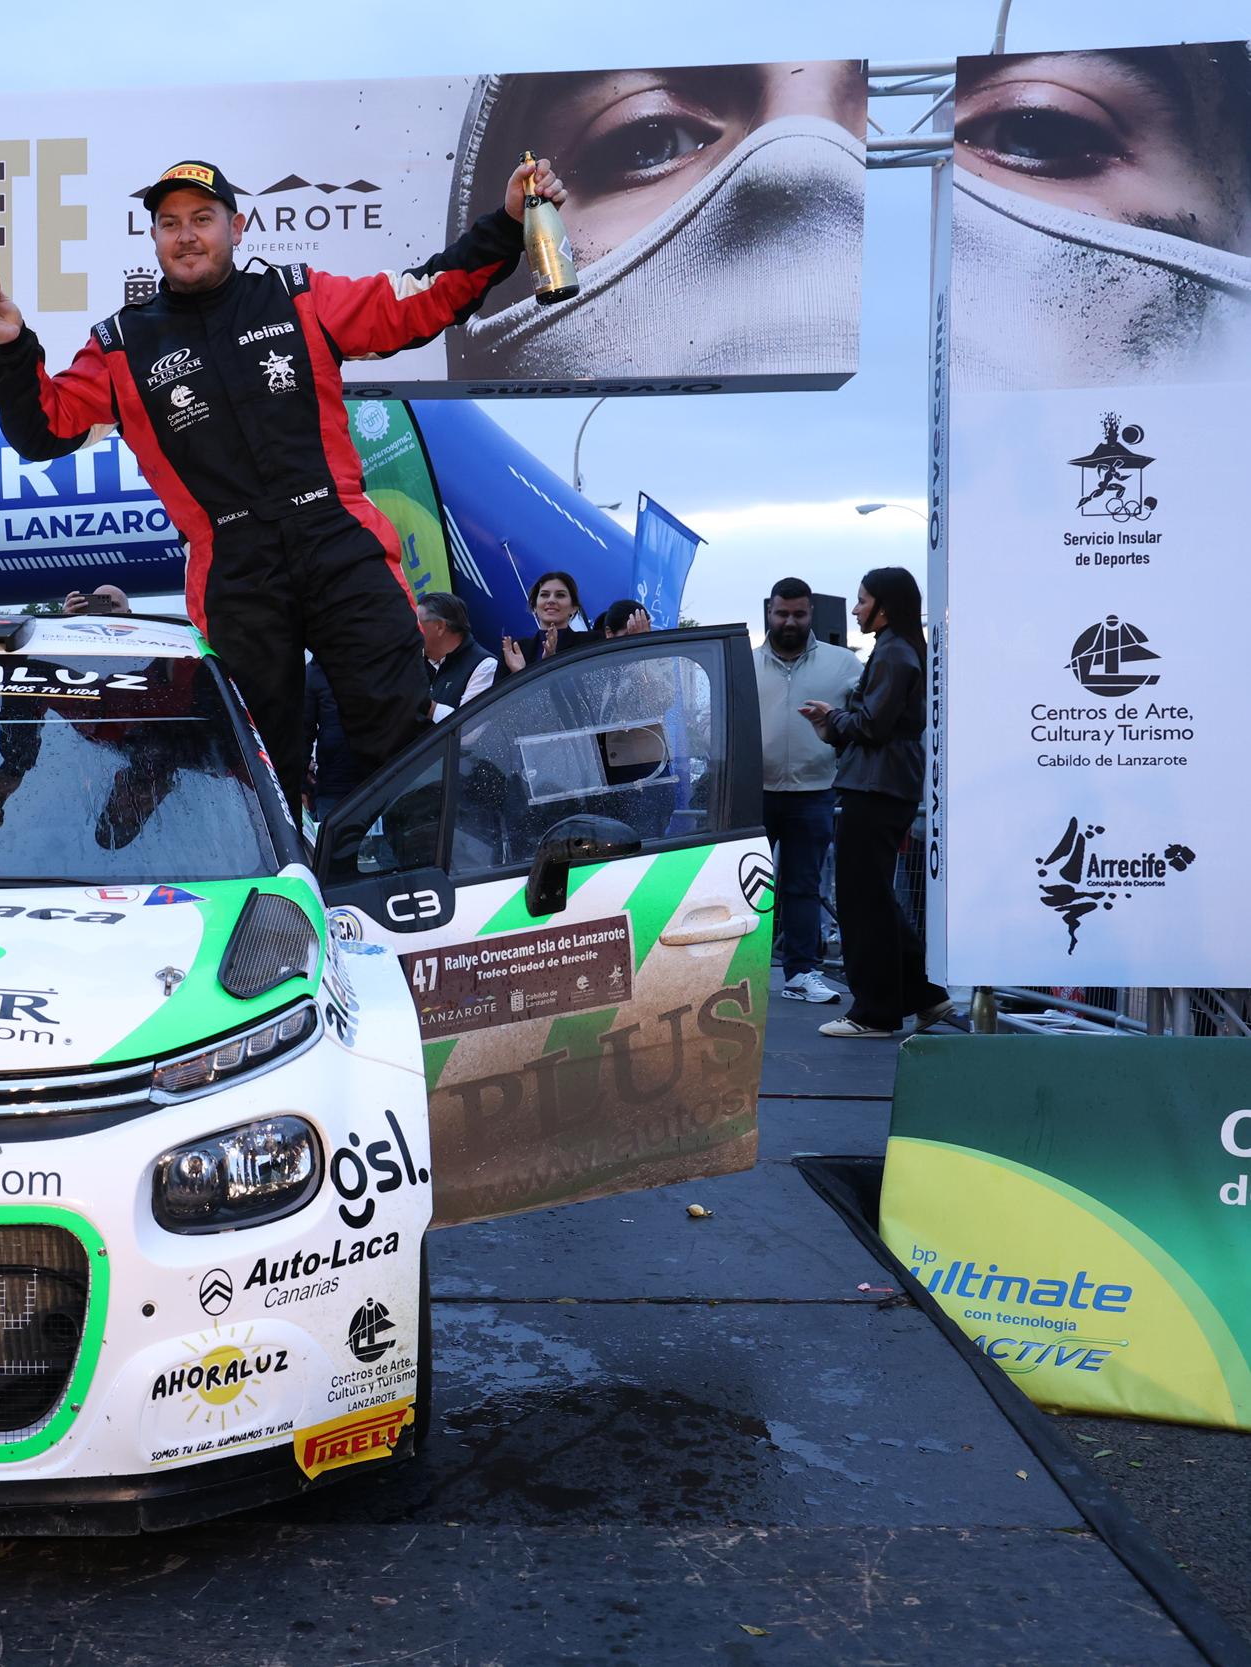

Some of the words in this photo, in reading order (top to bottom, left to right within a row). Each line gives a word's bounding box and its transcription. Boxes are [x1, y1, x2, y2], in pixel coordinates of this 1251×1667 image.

[127, 204, 383, 236] LAROTE
[246, 241, 320, 254] DIFERENTE
[238, 322, 295, 346] aleima
[147, 369, 175, 386] PLUS
[177, 359, 202, 374] CAR
[929, 291, 946, 551] Orvecame
[4, 505, 171, 543] LANZARO
[1063, 532, 1115, 547] Servicio
[1118, 530, 1163, 546] Insular
[1075, 552, 1092, 567] de
[1094, 551, 1151, 569] Deportes
[41, 686, 60, 695] TU
[66, 688, 101, 697] VIDA
[1031, 703, 1108, 721] Centros
[1114, 702, 1138, 720] de
[1145, 702, 1194, 721] Arte,
[1031, 725, 1102, 743] Cultura
[1103, 730, 1115, 746] y
[1118, 724, 1195, 742] Turismo
[929, 623, 941, 881] Orvecame
[1037, 753, 1091, 768] Cabildo
[1095, 754, 1113, 768] de
[1117, 753, 1188, 768] Lanzarote
[1086, 853, 1167, 879] Arrecife
[386, 889, 442, 923] C3
[444, 953, 479, 972] Rallye
[480, 945, 536, 965] Orvecame
[537, 939, 556, 956] Isla
[557, 936, 572, 951] de
[573, 927, 626, 948] Lanzarote
[412, 956, 439, 993] 47
[476, 967, 508, 981] Trofeo
[509, 959, 546, 975] Ciudad
[547, 957, 560, 967] de
[561, 950, 599, 966] Arrecife
[420, 1002, 498, 1026] LANZAROTE
[243, 1231, 400, 1290] Auto-Laca
[911, 1245, 937, 1266] bp
[263, 1276, 340, 1309] Canarias
[963, 1308, 992, 1322] con
[996, 1312, 1078, 1333] tecnología
[151, 1349, 289, 1401] AHORALUZ
[327, 1384, 367, 1403] Cultura
[377, 1370, 417, 1388] Turismo
[330, 1369, 374, 1388] Centros
[375, 1364, 388, 1376] de
[390, 1358, 413, 1372] Arte,
[347, 1390, 398, 1412] LANZAROTE
[151, 1448, 179, 1461] SOMOS
[182, 1445, 193, 1455] TU
[217, 1428, 263, 1447] ILUMINAMOS
[265, 1426, 275, 1435] TU
[277, 1420, 294, 1433] VIDA
[303, 1408, 408, 1470] PIRELL
